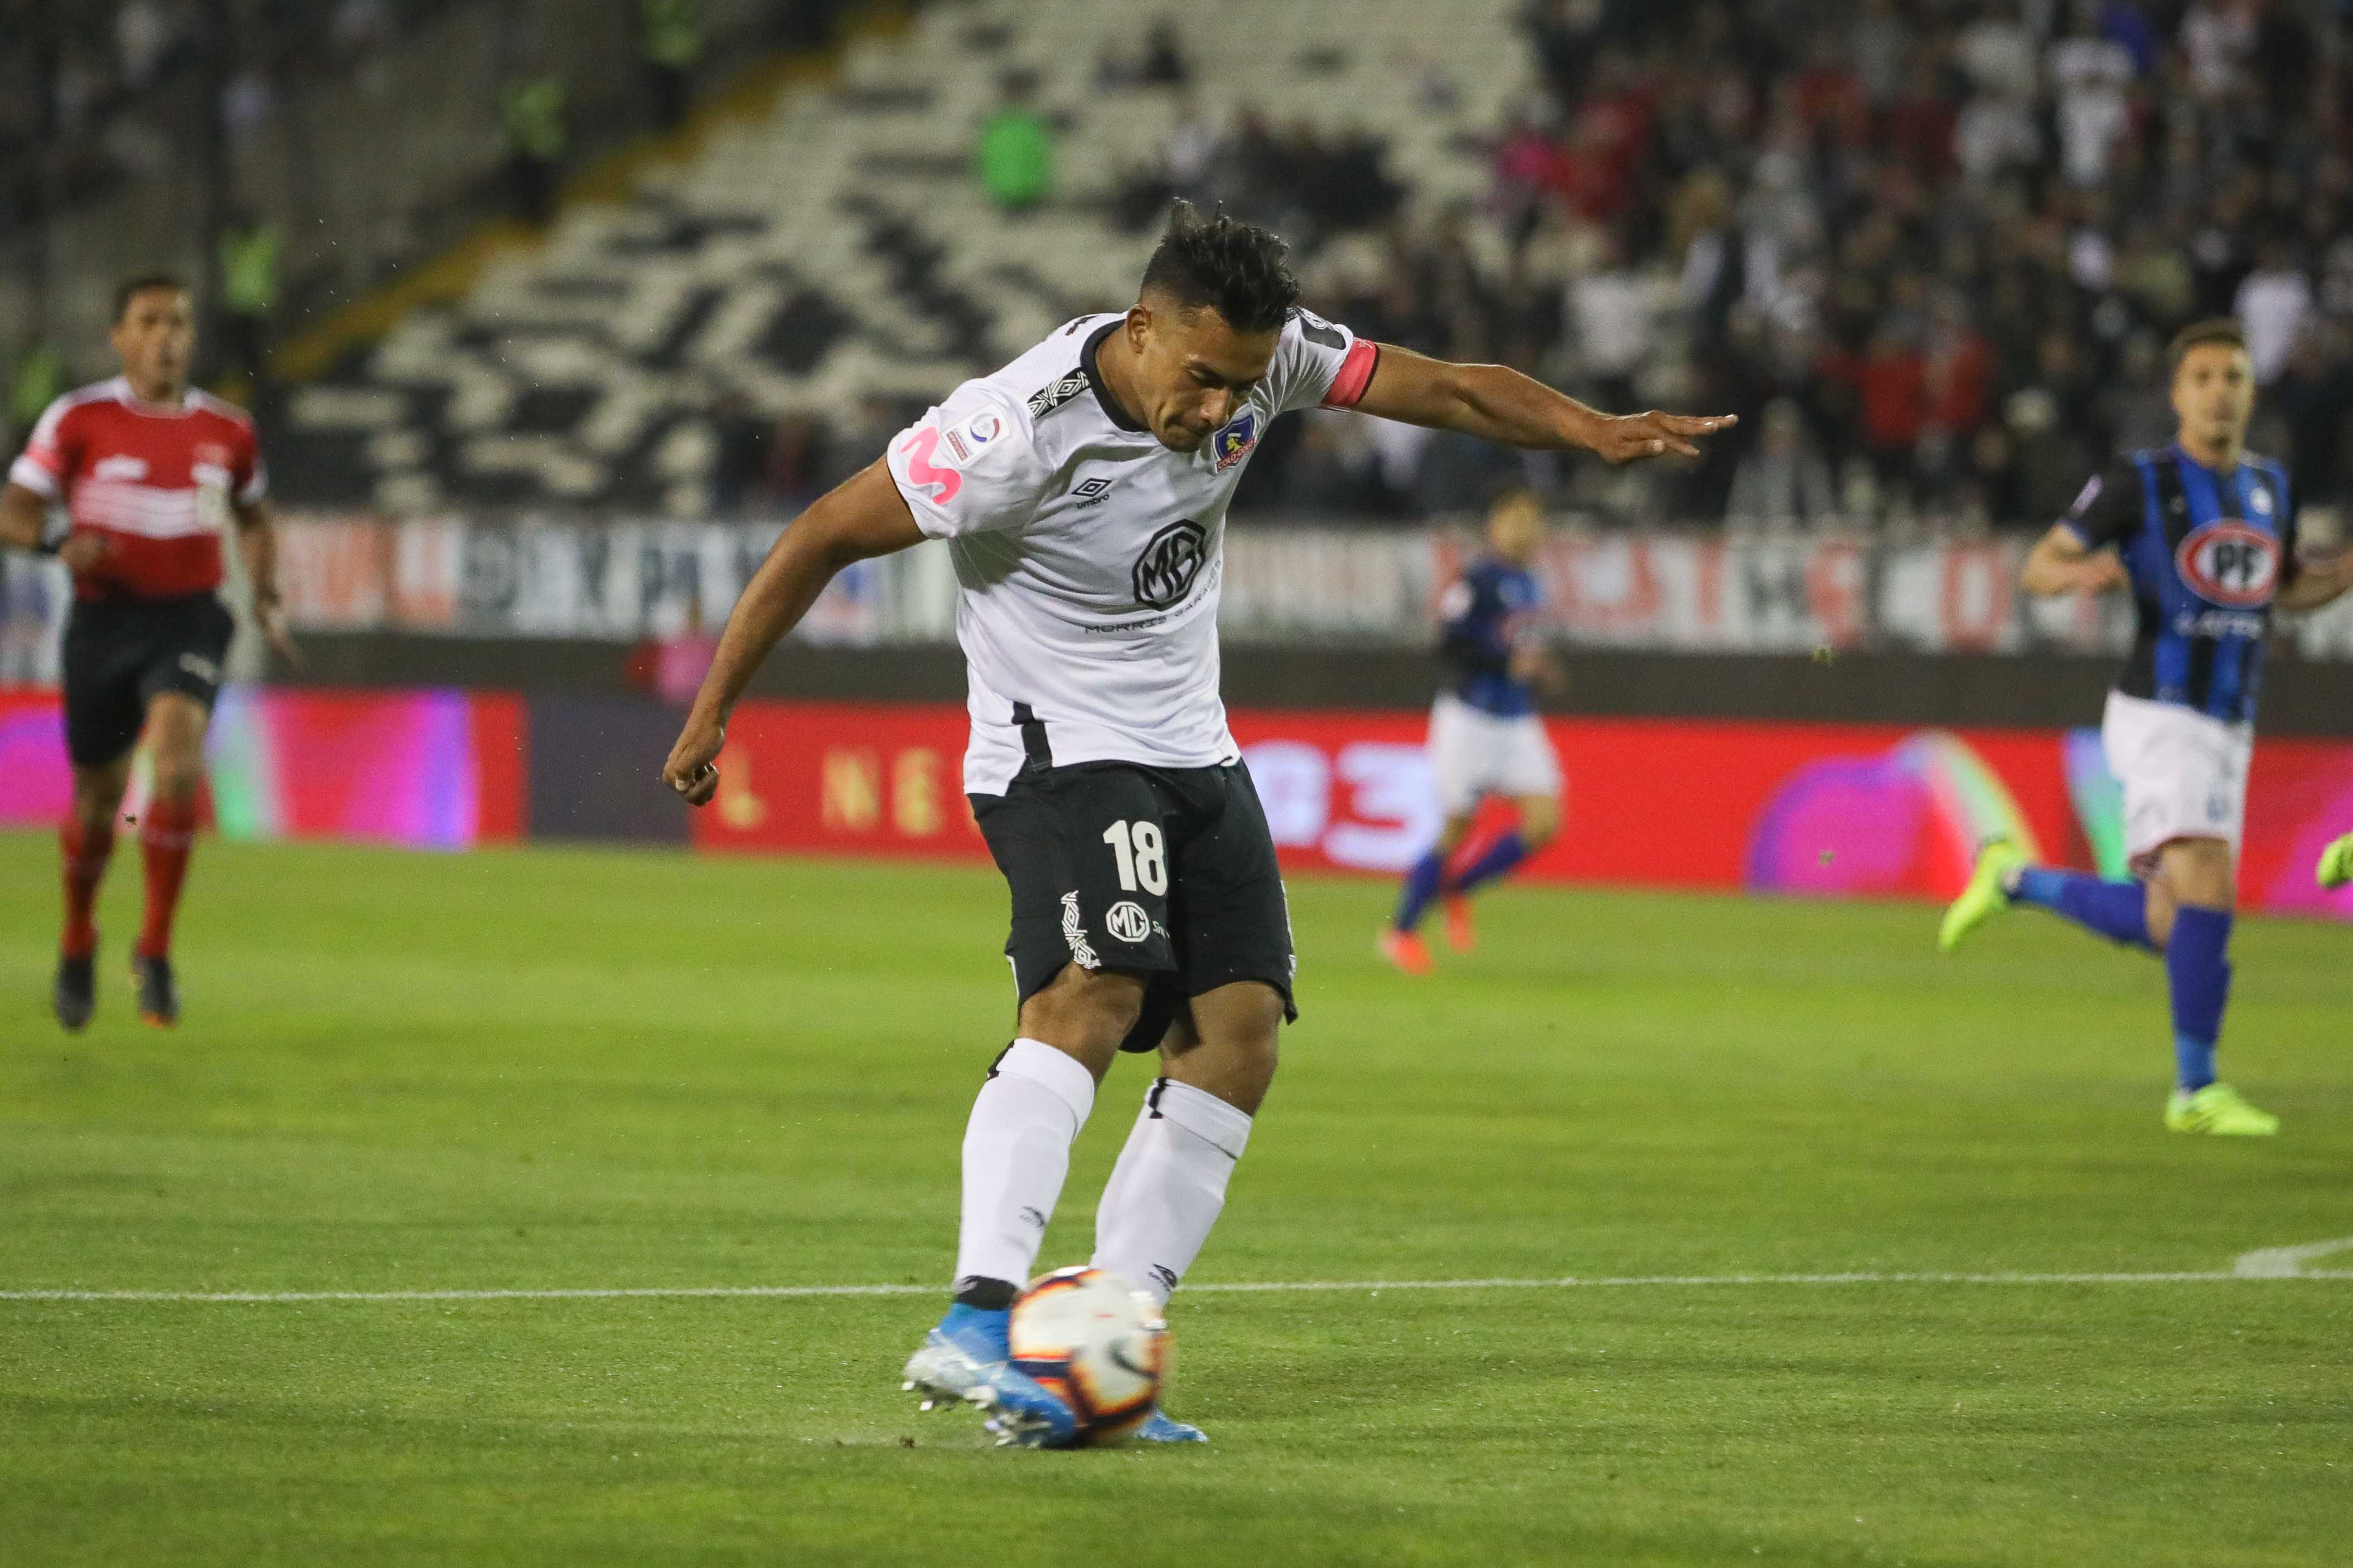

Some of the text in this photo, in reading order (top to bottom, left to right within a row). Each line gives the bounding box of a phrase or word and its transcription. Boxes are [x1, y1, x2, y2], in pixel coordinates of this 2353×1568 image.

[1076, 493, 1110, 509] umbro
[1142, 531, 1197, 601] MG
[1084, 615, 1168, 634] MORRIS
[1102, 819, 1168, 896] 18
[1110, 905, 1146, 938] MG
